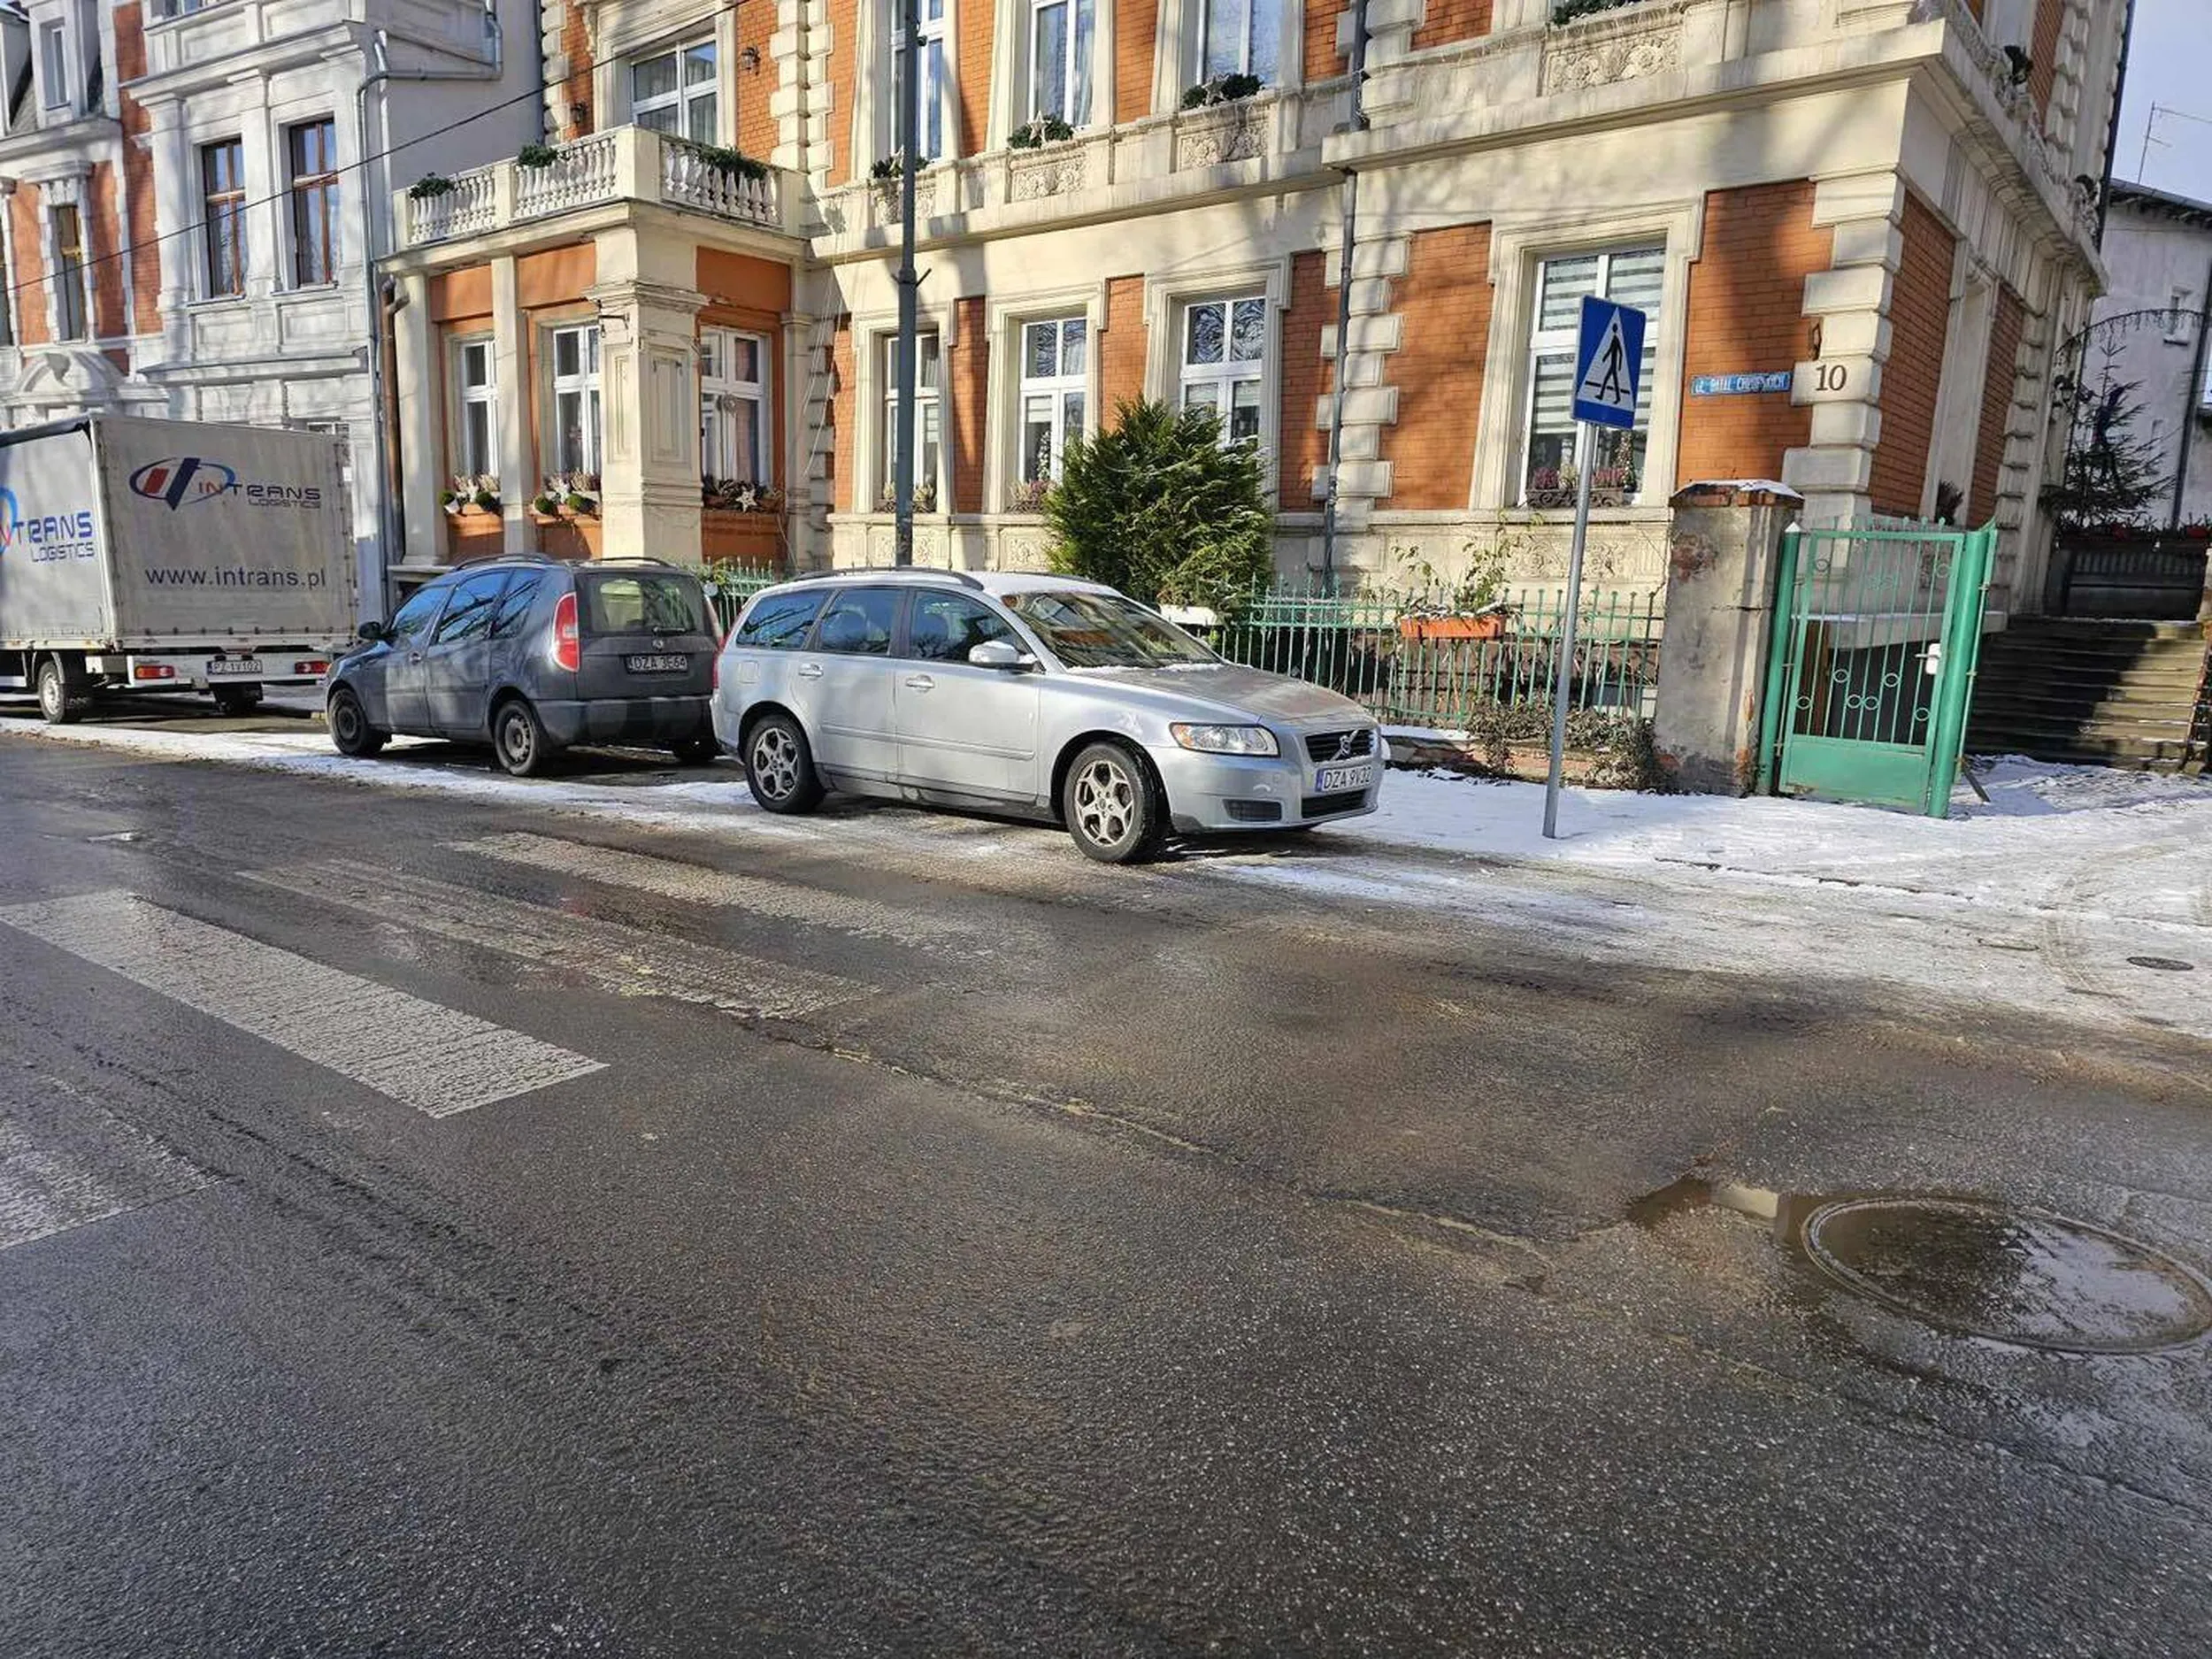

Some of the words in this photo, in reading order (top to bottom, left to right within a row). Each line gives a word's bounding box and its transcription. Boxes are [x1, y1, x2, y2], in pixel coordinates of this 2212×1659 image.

[1816, 365, 1847, 391] 10
[198, 480, 321, 501] INTRANS
[0, 511, 93, 545] NTRANS
[29, 541, 95, 563] LOGISTICS
[145, 566, 326, 590] www.intrans.pl
[1324, 771, 1347, 789] DZA
